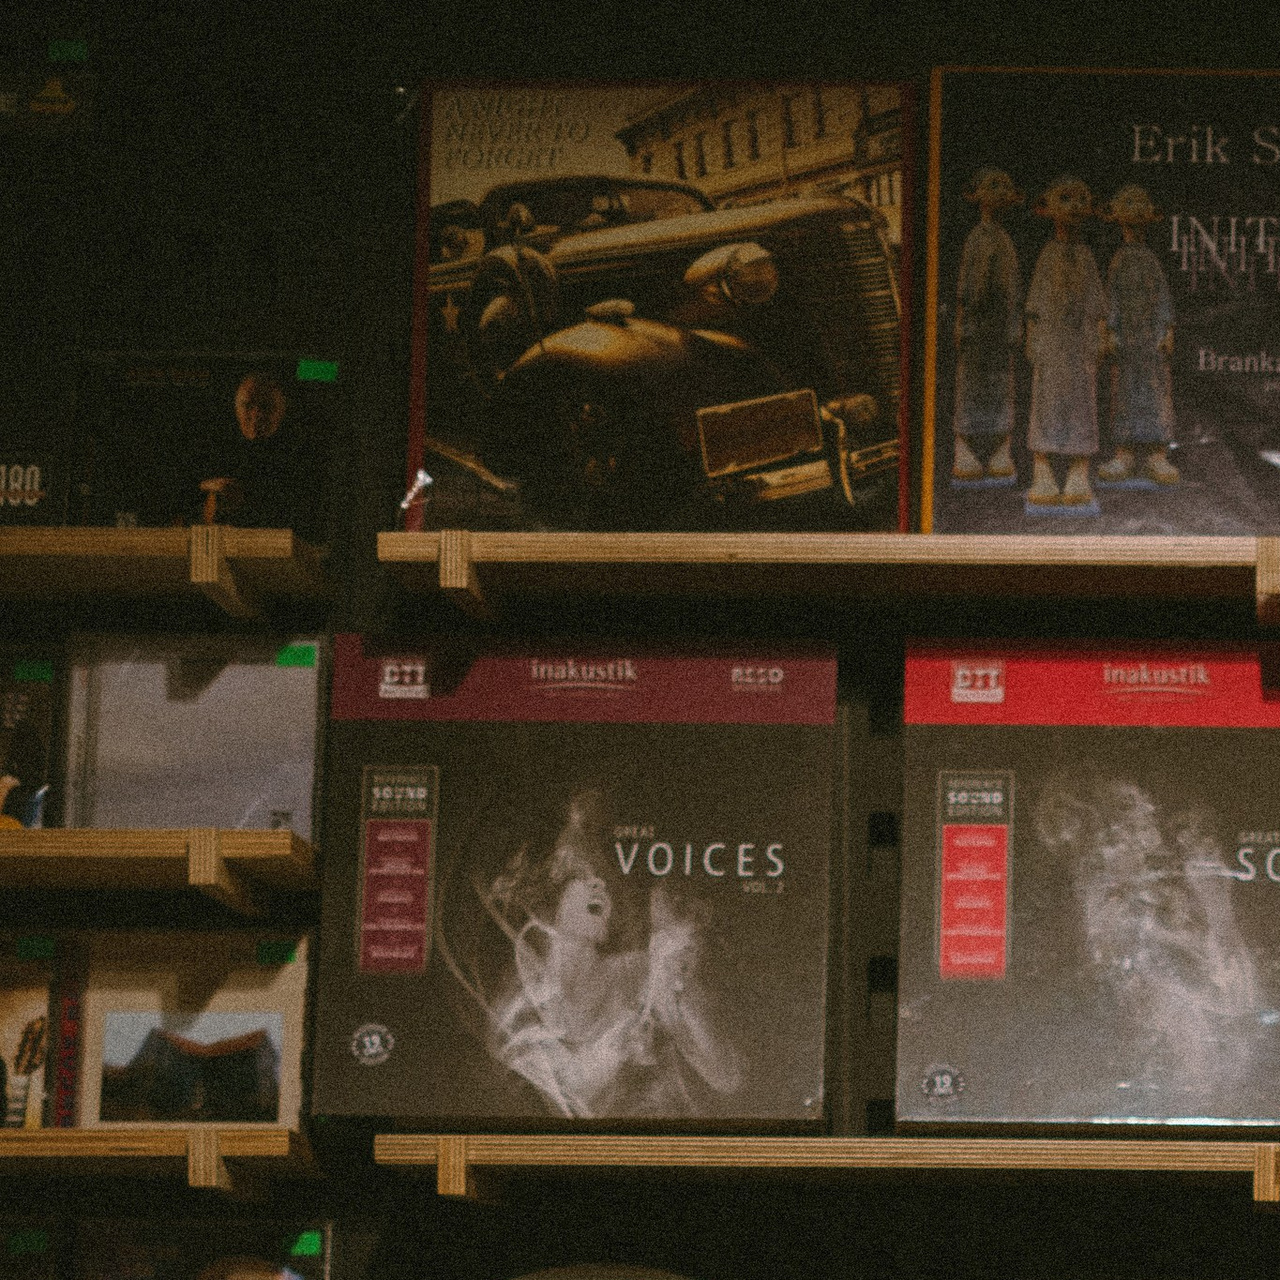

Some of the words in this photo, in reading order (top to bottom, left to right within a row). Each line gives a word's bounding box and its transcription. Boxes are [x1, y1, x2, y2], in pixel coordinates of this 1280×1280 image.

[1131, 124, 1231, 164] Erik
[530, 659, 638, 682] inakustik
[1103, 663, 1210, 686] inakustik
[614, 841, 785, 878] VOICES
